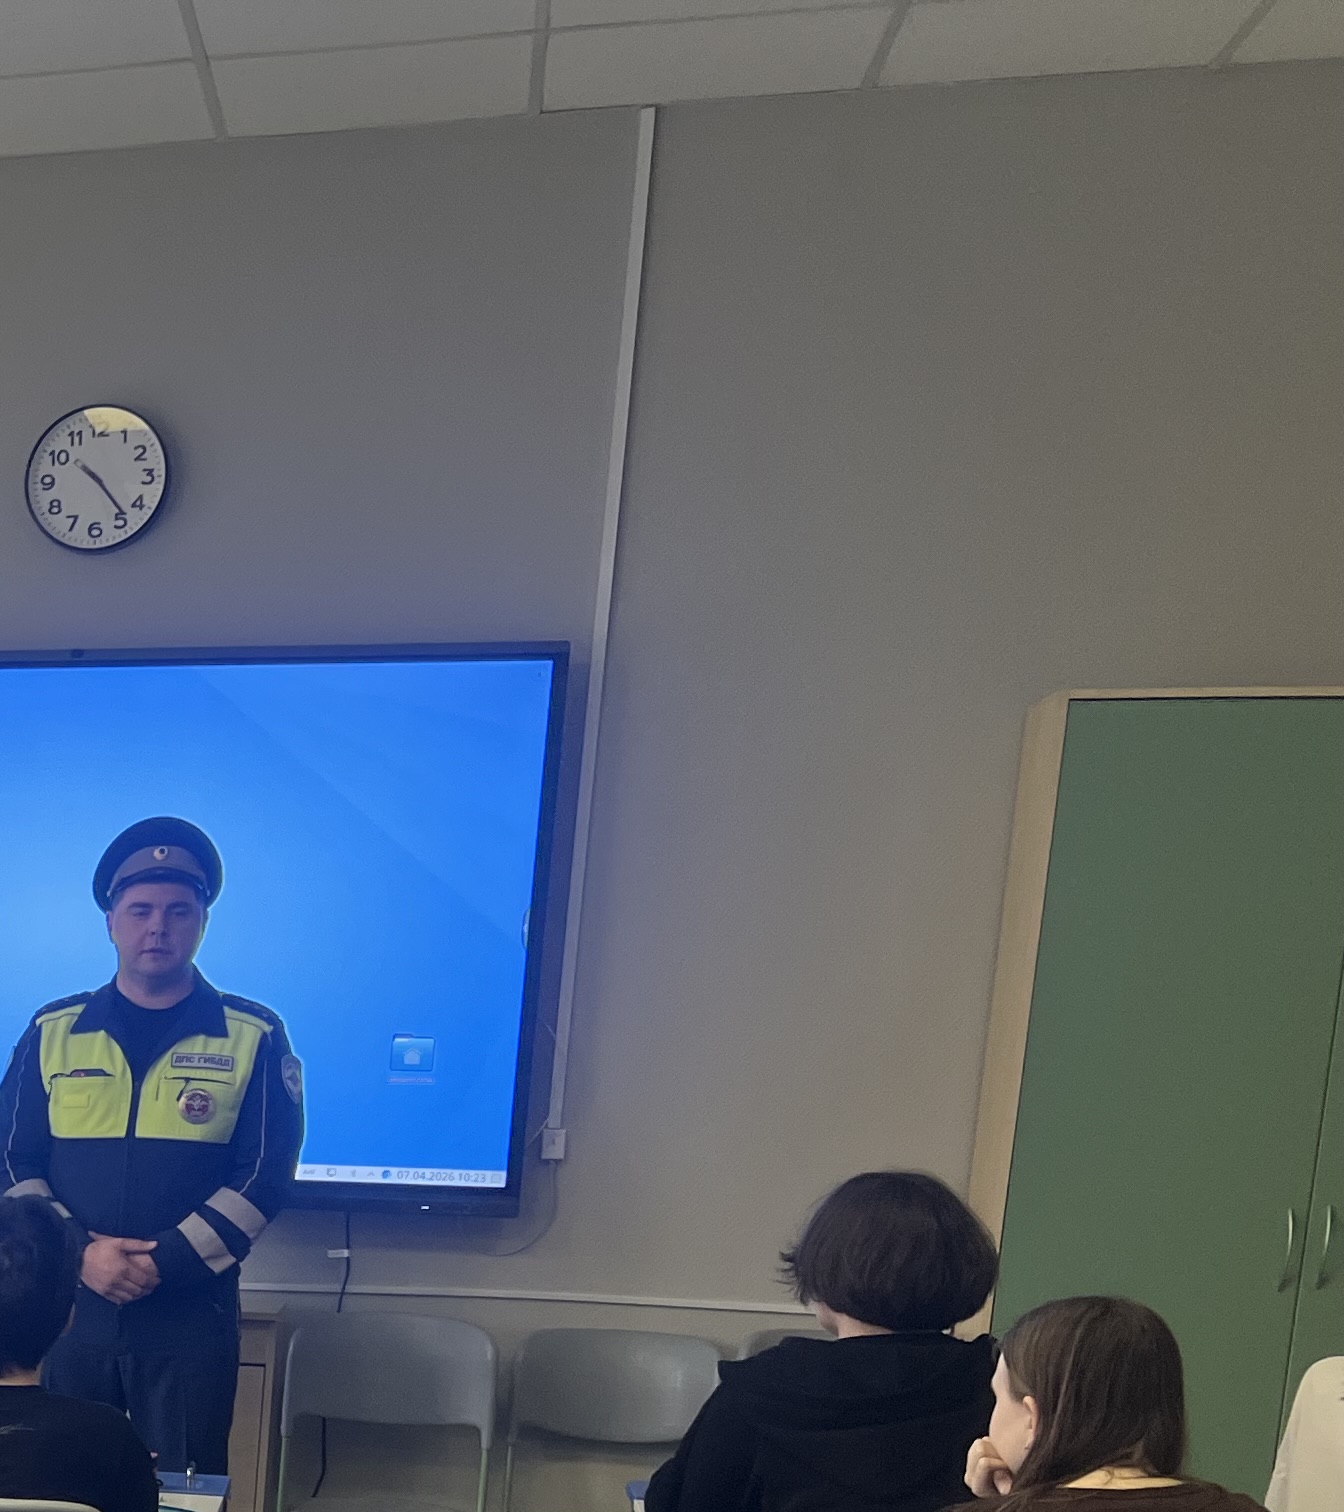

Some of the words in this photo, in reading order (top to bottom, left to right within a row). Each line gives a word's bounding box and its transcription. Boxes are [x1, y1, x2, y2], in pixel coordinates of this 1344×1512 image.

[68, 430, 83, 446] 11
[121, 428, 128, 444] 1
[48, 449, 70, 466] 10
[134, 445, 147, 461] 2
[40, 474, 55, 491] 9
[141, 468, 155, 485] 3
[48, 499, 62, 515] 8
[131, 494, 145, 511] 4
[66, 515, 79, 532] 7
[113, 513, 128, 529] 5
[87, 522, 103, 538] 6
[174, 1055, 195, 1064] ДПС
[198, 1056, 230, 1067] ГИБДД
[396, 1170, 455, 1182] 07.04.2026
[458, 1172, 487, 1183] 10:23
